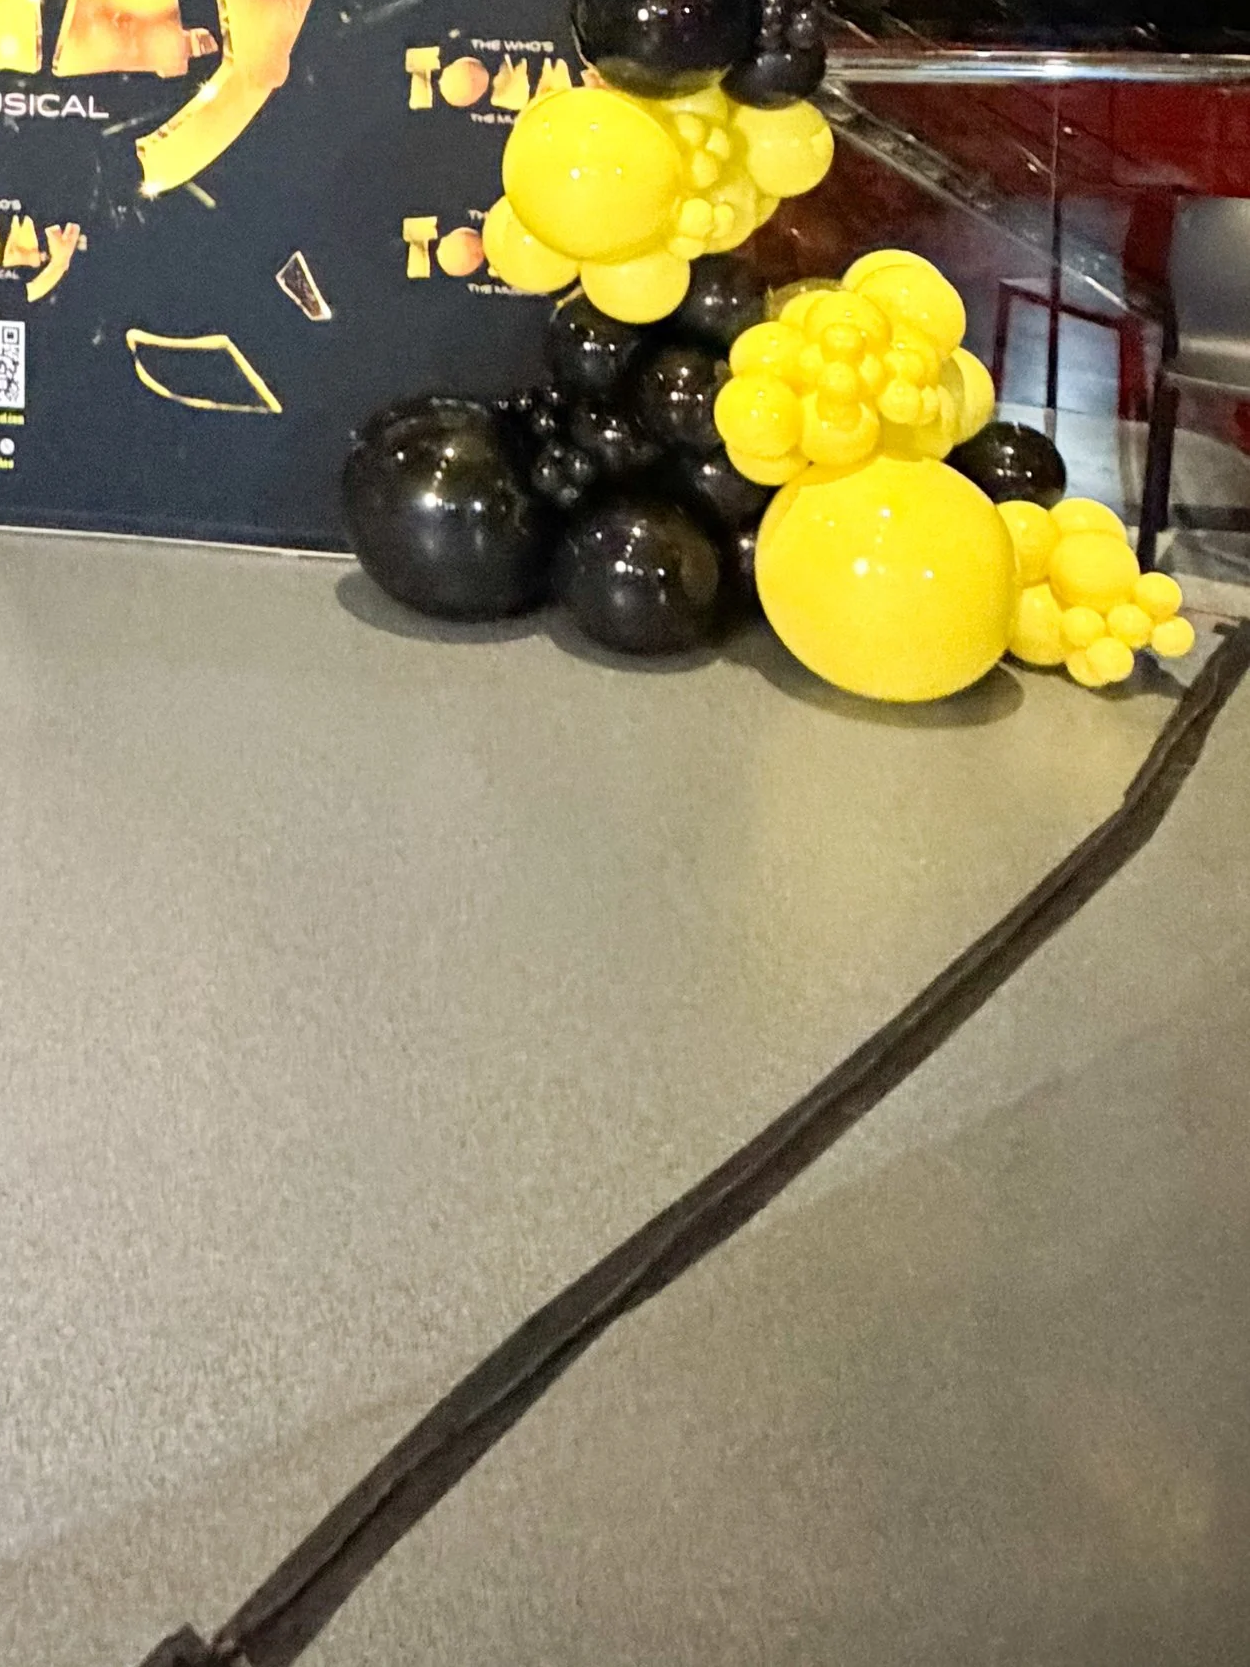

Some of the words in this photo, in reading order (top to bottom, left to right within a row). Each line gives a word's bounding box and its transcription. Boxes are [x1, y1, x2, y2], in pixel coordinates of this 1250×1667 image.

[471, 39, 501, 51] THE
[505, 40, 554, 52] WHO'S
[406, 46, 612, 110] TOMM
